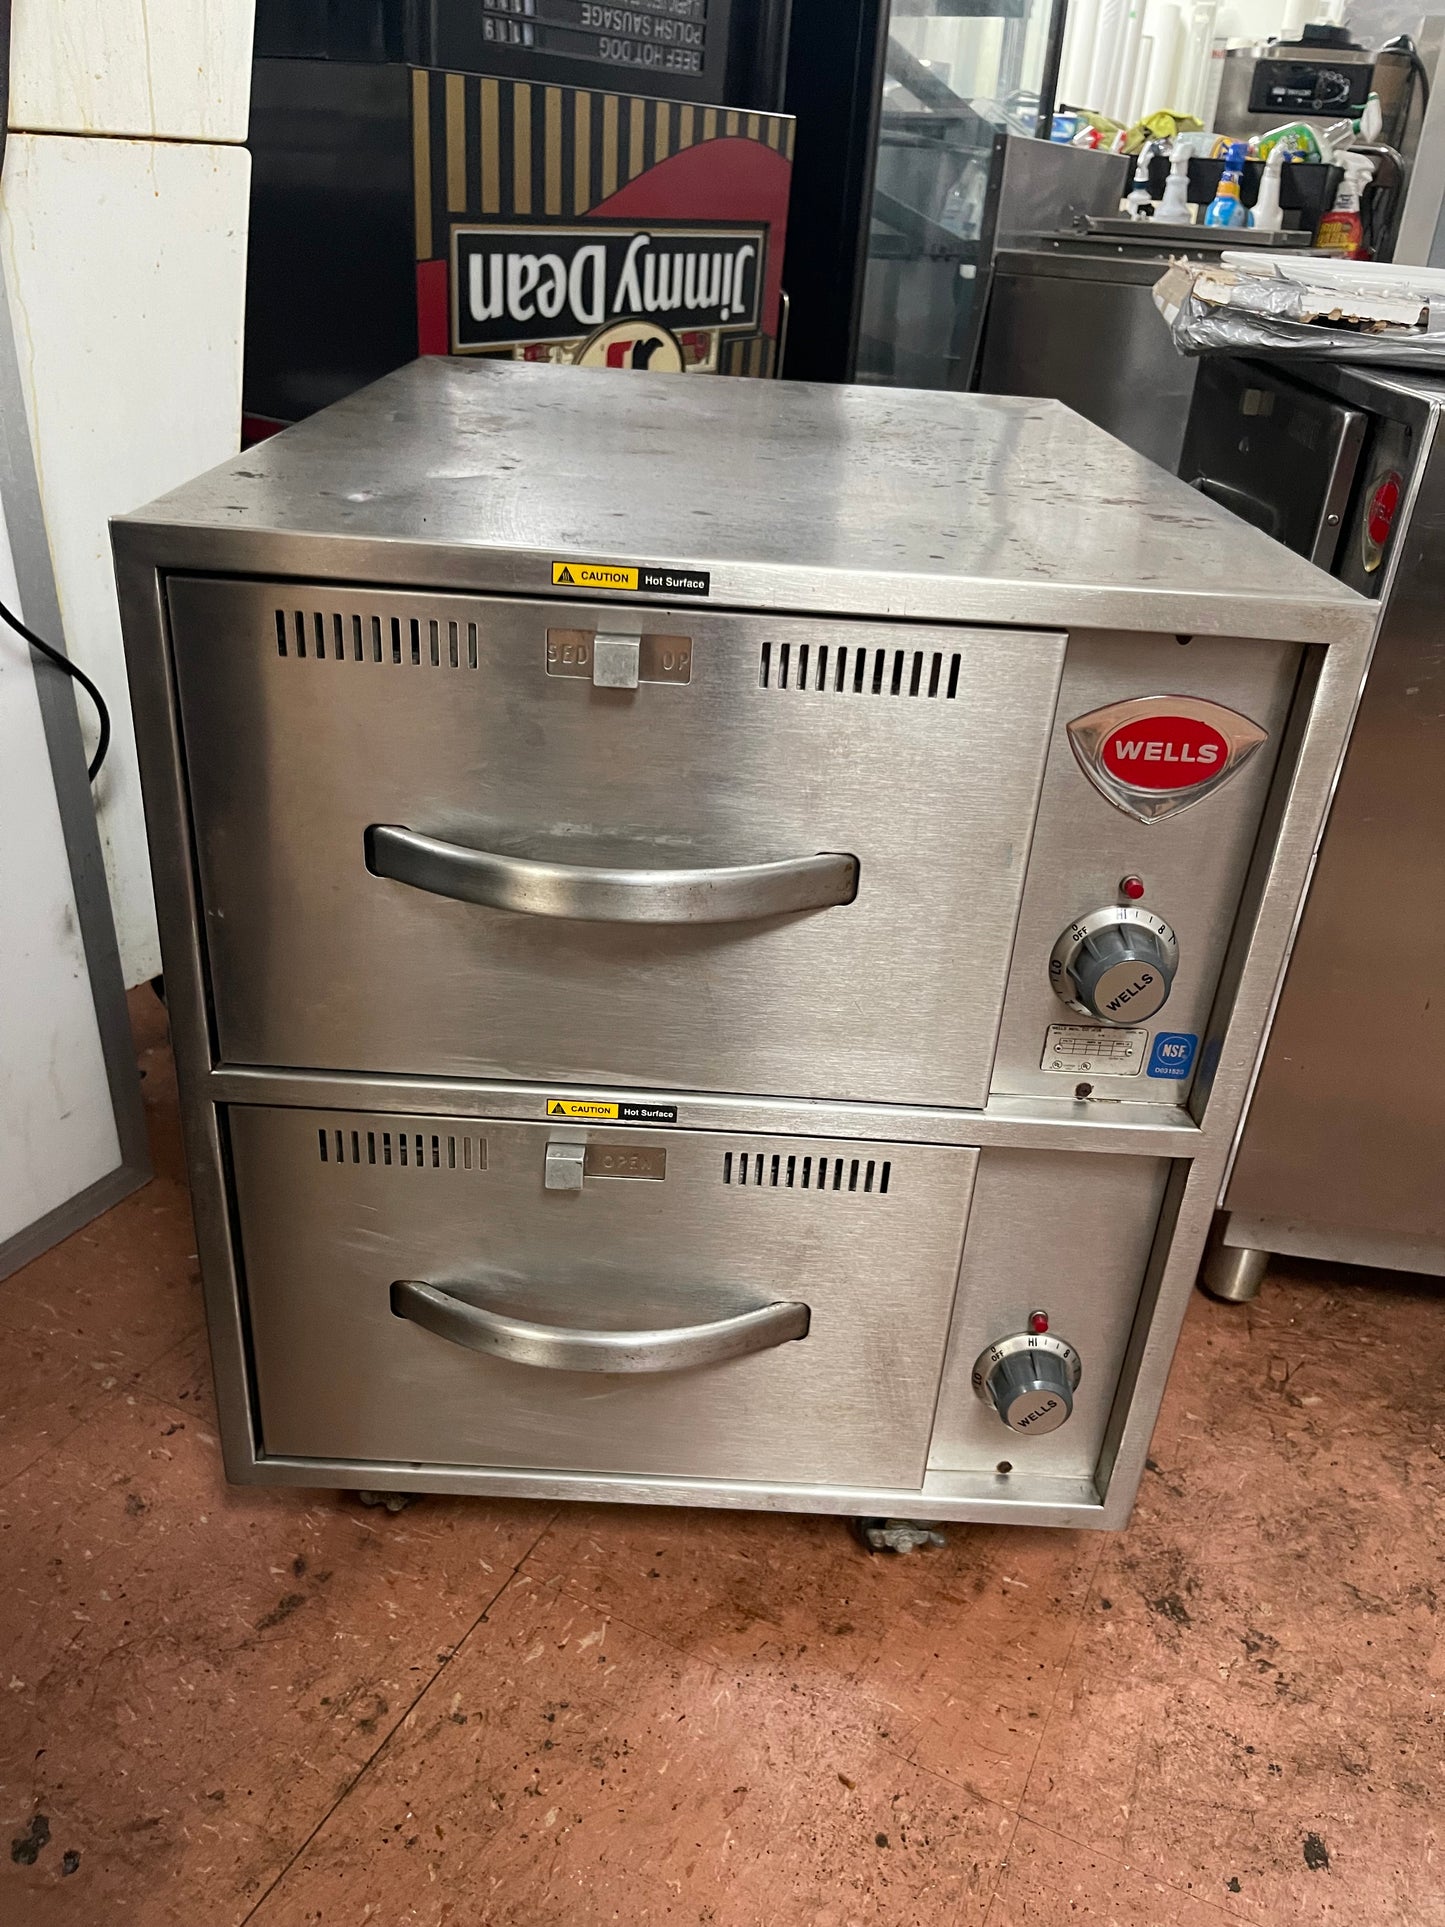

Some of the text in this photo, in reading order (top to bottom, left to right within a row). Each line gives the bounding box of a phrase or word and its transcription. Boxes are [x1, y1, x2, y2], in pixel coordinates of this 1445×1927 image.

[582, 4, 650, 36] SAUSAGE
[654, 19, 701, 45] POLISH
[600, 37, 631, 60] DOG
[634, 43, 662, 65] HOT
[664, 50, 700, 72] BEEF
[468, 234, 755, 326] Jimmy Dean
[580, 571, 705, 589] CAUTION Hot Surface
[1115, 740, 1219, 764] WELLS
[1072, 926, 1089, 941] OFF
[1157, 924, 1166, 935] 8
[1050, 959, 1062, 975] LO
[1105, 973, 1154, 1012] WELLS
[1162, 1044, 1187, 1058] NSF
[571, 1105, 674, 1118] CAUTION Hot Surface
[1028, 1337, 1038, 1347] HI
[991, 1350, 1005, 1362] OFF
[1063, 1349, 1071, 1358] 8
[1017, 1399, 1058, 1428] WELLS
